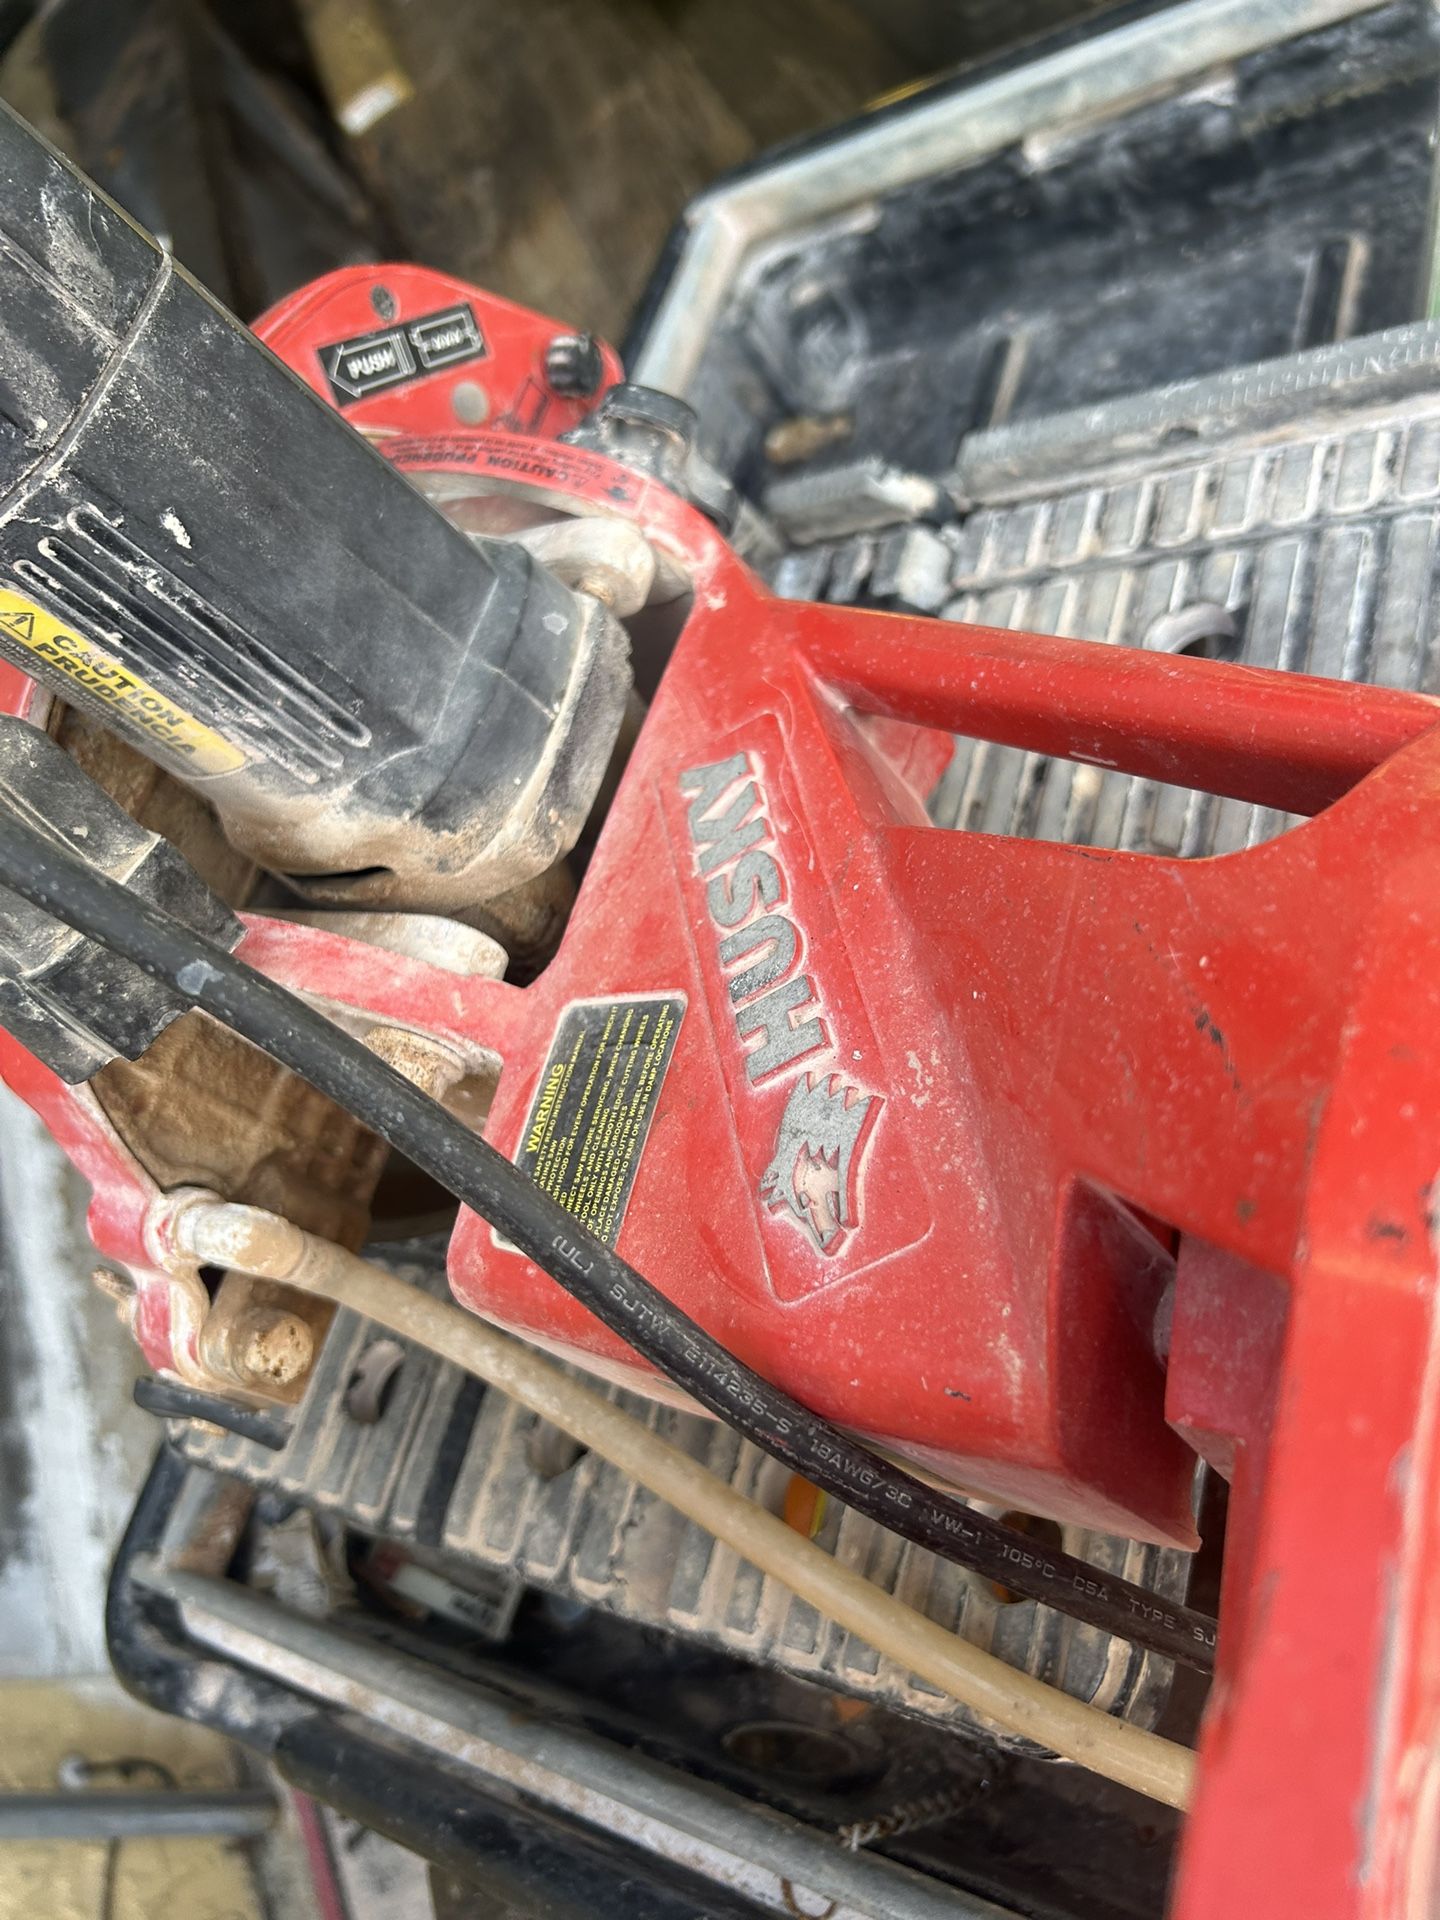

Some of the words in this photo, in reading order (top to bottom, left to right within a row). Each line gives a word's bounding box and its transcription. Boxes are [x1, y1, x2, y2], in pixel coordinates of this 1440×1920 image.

[347, 349, 396, 378] PUSH
[488, 456, 567, 481] CAUTION
[34, 643, 196, 754] PRUDENCIA
[53, 634, 186, 727] CAUTION
[680, 751, 835, 1084] HUSKY
[556, 1156, 569, 1183] HOOD
[565, 1137, 575, 1155] FOR
[571, 1108, 584, 1136] EVERY
[580, 1059, 600, 1107] OPERATION
[596, 1040, 606, 1058] FOR
[602, 1013, 615, 1040] WHICH
[573, 1163, 584, 1183] SAW
[579, 1126, 596, 1162] BEFORE
[606, 1051, 619, 1077] WHEN
[615, 1007, 634, 1051] CHANGING
[641, 1092, 649, 1102] IN
[645, 1066, 658, 1092] DAMP
[525, 1061, 564, 1154] WARNING
[533, 1144, 548, 1176] SAFETY
[544, 1118, 556, 1143] READ
[552, 1062, 574, 1117] INSTRUCTION
[570, 1030, 586, 1062] MANUAL
[578, 1198, 591, 1223] TOOL
[586, 1174, 599, 1198] ONLY
[593, 1149, 605, 1173] WITH
[600, 1111, 617, 1149] SMOOTH
[612, 1085, 625, 1110] EDGE
[620, 1048, 637, 1086] CUTTING
[633, 1013, 649, 1048] WHEELS
[592, 1204, 608, 1237] PLACE
[601, 1157, 622, 1203] DAMAGED
[616, 1118, 633, 1156] CUTTING
[628, 1085, 643, 1117] WHEEL
[638, 1050, 654, 1086] BEFORE
[649, 1003, 670, 1050] OPERATING
[635, 1102, 646, 1121] USE
[585, 1152, 596, 1172] AND
[591, 1106, 610, 1151] CLEANING
[609, 1104, 628, 1147] GROOVES
[631, 1122, 640, 1136] OR
[545, 1135, 567, 1192] PROTECTION
[547, 1139, 558, 1158] SAW
[603, 1148, 615, 1168] AND
[620, 1160, 629, 1173] TO
[624, 1137, 636, 1159] RAIN
[589, 1169, 609, 1216] OPENINGS
[608, 1174, 625, 1211] EXPOSE
[585, 1217, 594, 1230] OF
[602, 1212, 614, 1233] NOT
[551, 1234, 595, 1274] (UL)
[608, 1282, 670, 1337] SJTW
[682, 1345, 794, 1435] E114235-S
[929, 1509, 983, 1545] VW-1
[1129, 1598, 1178, 1629] TYPE
